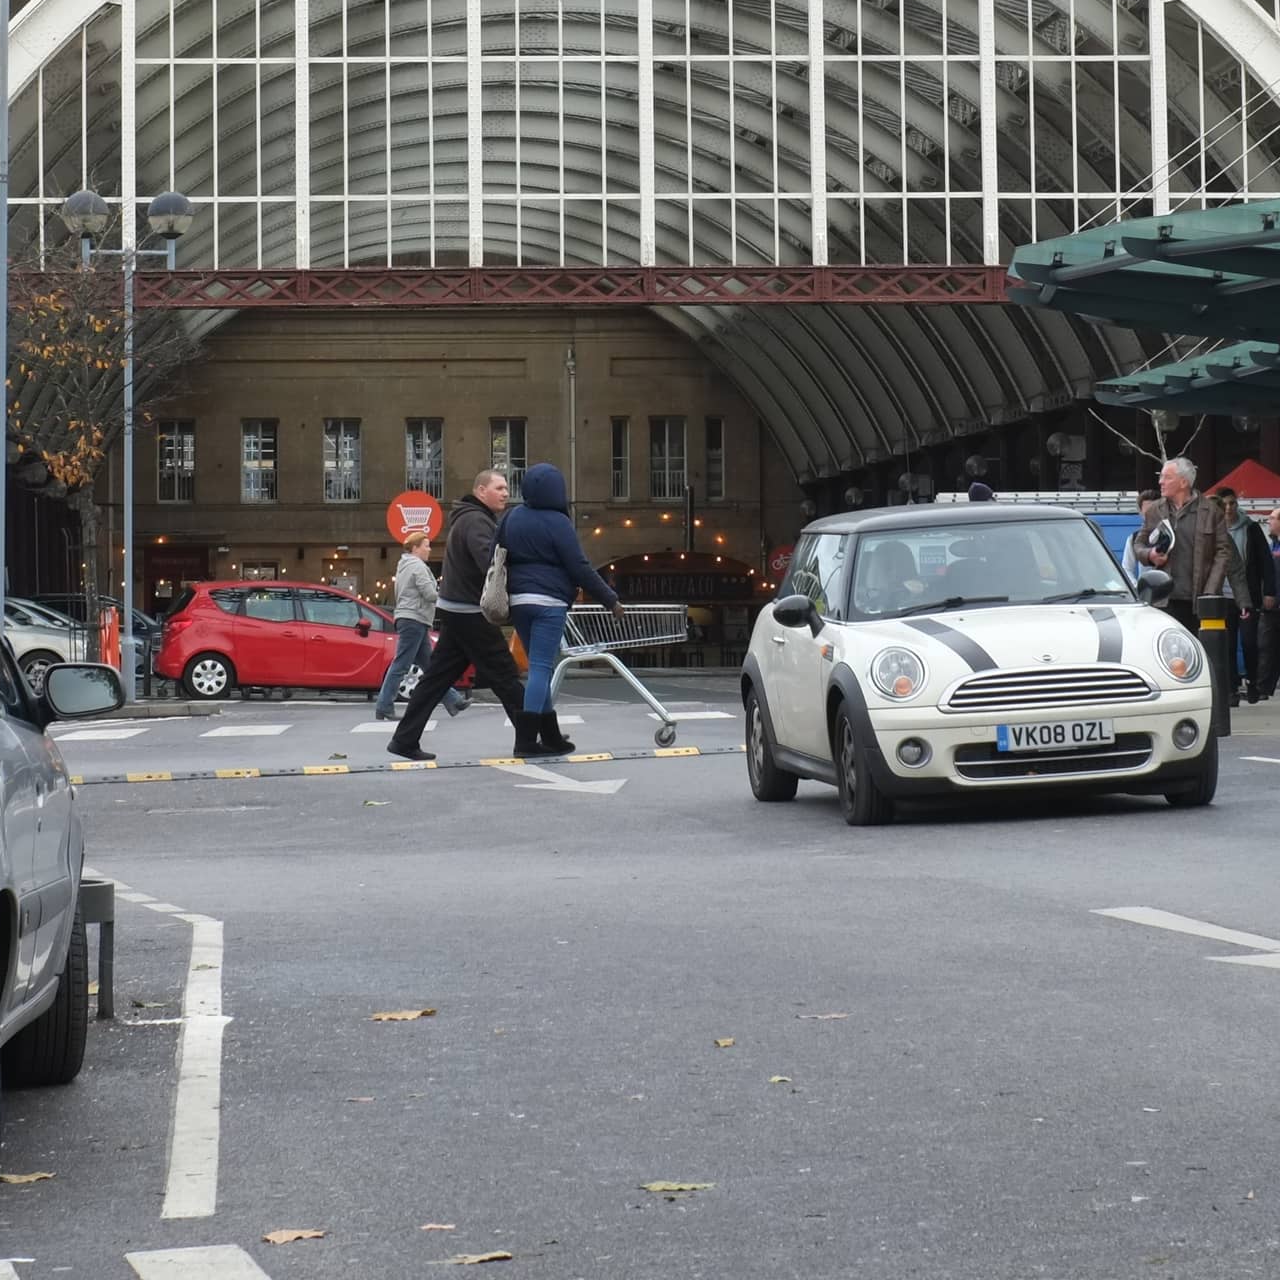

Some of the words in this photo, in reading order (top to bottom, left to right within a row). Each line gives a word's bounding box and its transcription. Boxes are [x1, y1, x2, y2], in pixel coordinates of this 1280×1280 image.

[628, 575, 657, 596] BATH
[661, 575, 695, 596] PIZZA
[1012, 724, 1066, 746] VK08
[1072, 721, 1111, 742] OZL
